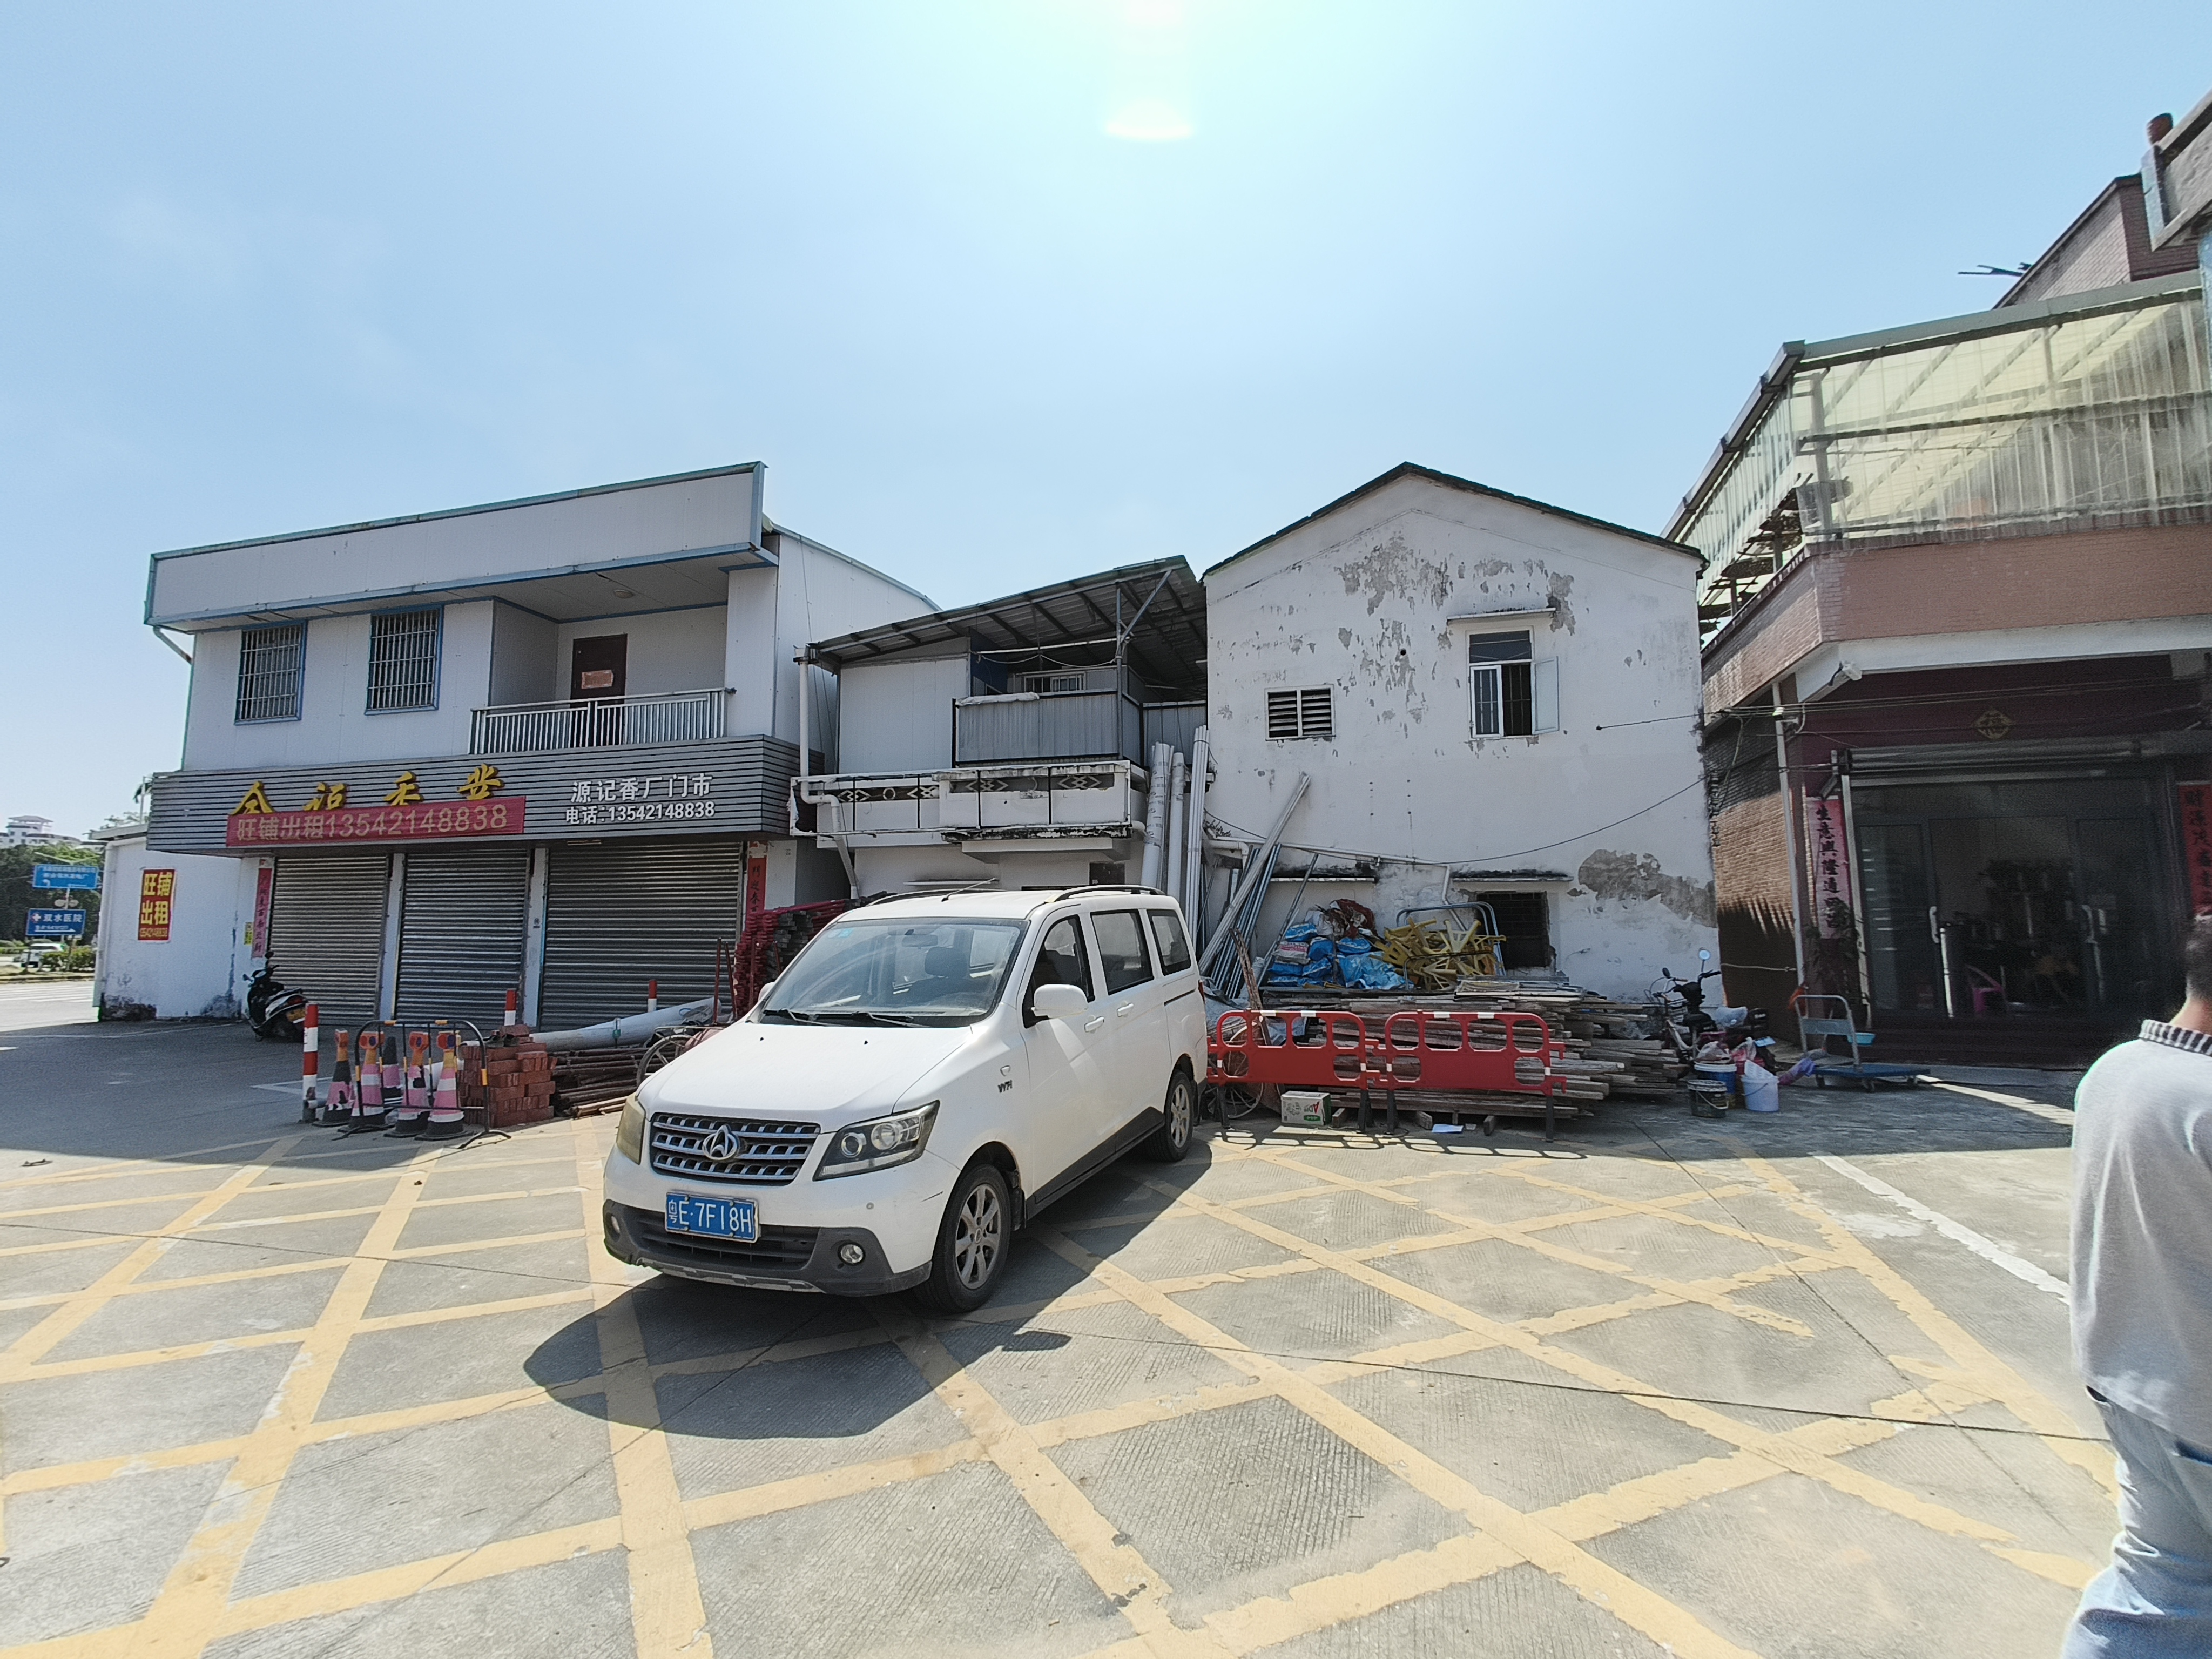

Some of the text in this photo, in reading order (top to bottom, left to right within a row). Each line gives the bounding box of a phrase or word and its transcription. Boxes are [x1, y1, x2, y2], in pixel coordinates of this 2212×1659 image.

[570, 773, 712, 804] 源记香厂门市
[143, 872, 172, 896] 旺铺
[43, 913, 83, 922] 双水医院
[141, 900, 168, 925] 出租
